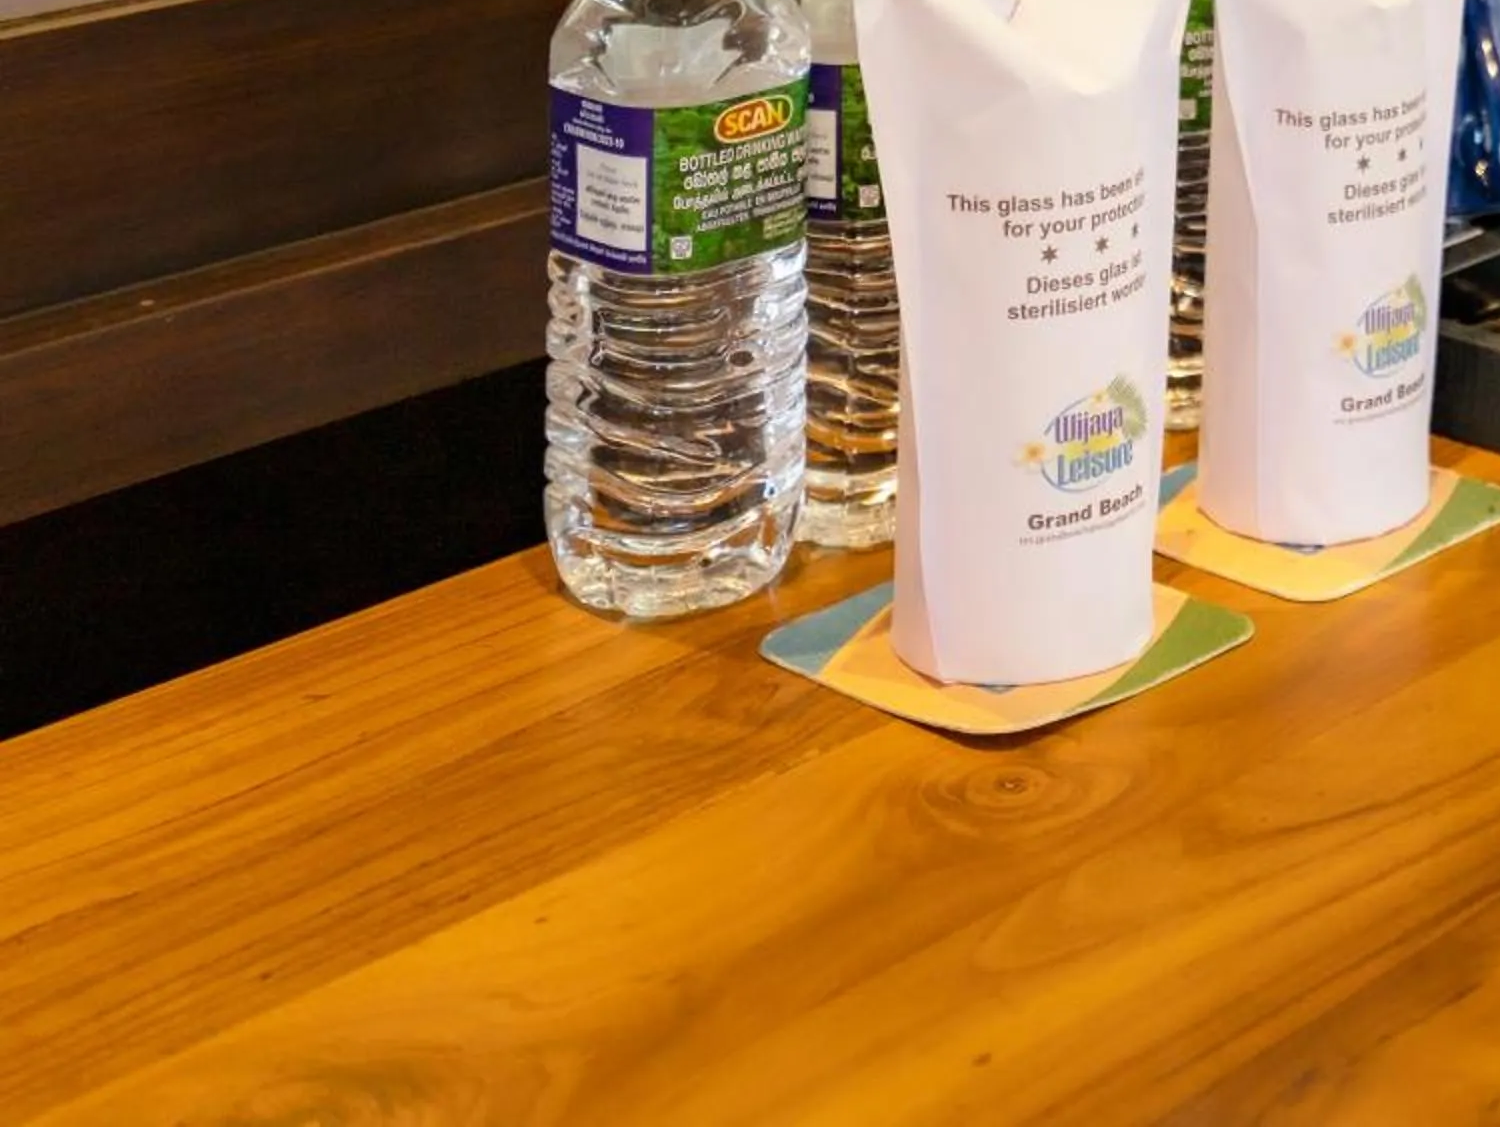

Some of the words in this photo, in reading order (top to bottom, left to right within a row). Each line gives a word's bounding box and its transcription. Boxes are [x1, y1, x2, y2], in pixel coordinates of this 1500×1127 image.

[723, 101, 784, 136] SCAN
[1275, 108, 1313, 129] This
[1319, 110, 1368, 132] glass
[1372, 105, 1399, 122] has
[1324, 133, 1351, 150] for
[1355, 129, 1391, 152] your
[680, 148, 735, 172] BOTTLED
[947, 194, 990, 212] This
[997, 195, 1054, 217] glass
[1061, 190, 1095, 209] has
[1100, 177, 1132, 200] been
[1344, 179, 1397, 201] Dieses
[1327, 196, 1406, 225] sterilisiert
[1003, 220, 1033, 237] for
[1039, 217, 1086, 240] your
[1026, 271, 1094, 295] Dieses
[1099, 259, 1128, 286] glas
[1007, 291, 1107, 321] sterilisiert
[1341, 388, 1393, 413] Grand
[1054, 406, 1123, 445] Wijaya
[1056, 439, 1133, 486] Leisure
[1027, 504, 1093, 530] Grand
[1099, 483, 1143, 516] Beach
